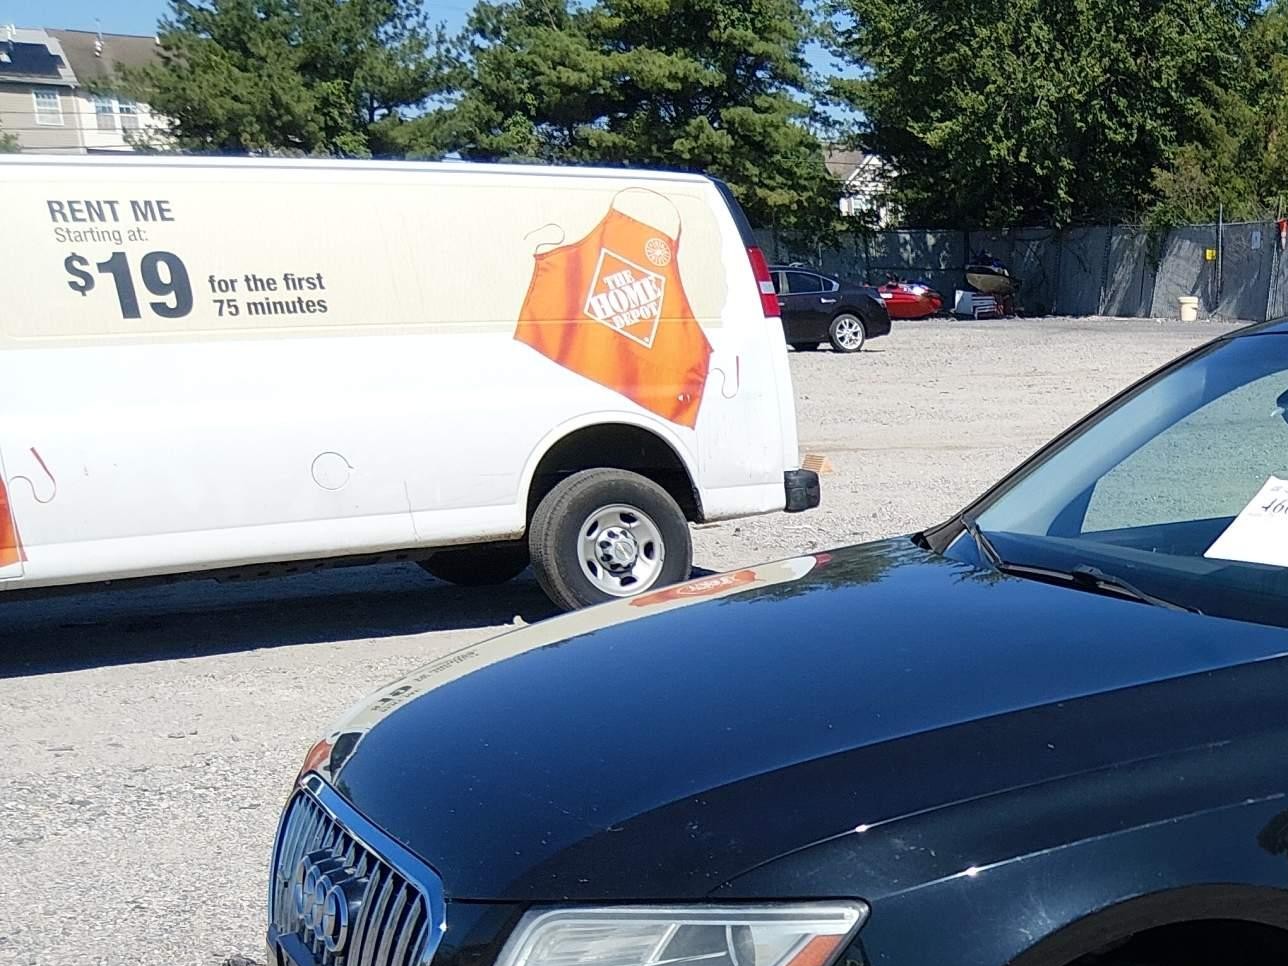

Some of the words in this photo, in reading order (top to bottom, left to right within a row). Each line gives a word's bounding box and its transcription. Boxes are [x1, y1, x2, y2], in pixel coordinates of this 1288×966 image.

[46, 200, 120, 222] RENT
[130, 200, 175, 222] ME
[54, 227, 123, 245] Starting
[127, 227, 149, 241] at:
[64, 250, 194, 319] $19
[208, 275, 238, 293] for
[244, 274, 278, 292] the
[283, 273, 326, 290] first
[603, 269, 633, 290] THE
[213, 299, 239, 317] 75
[246, 296, 328, 315] minutes
[590, 277, 662, 320] HOME
[611, 301, 659, 329] DEPOT
